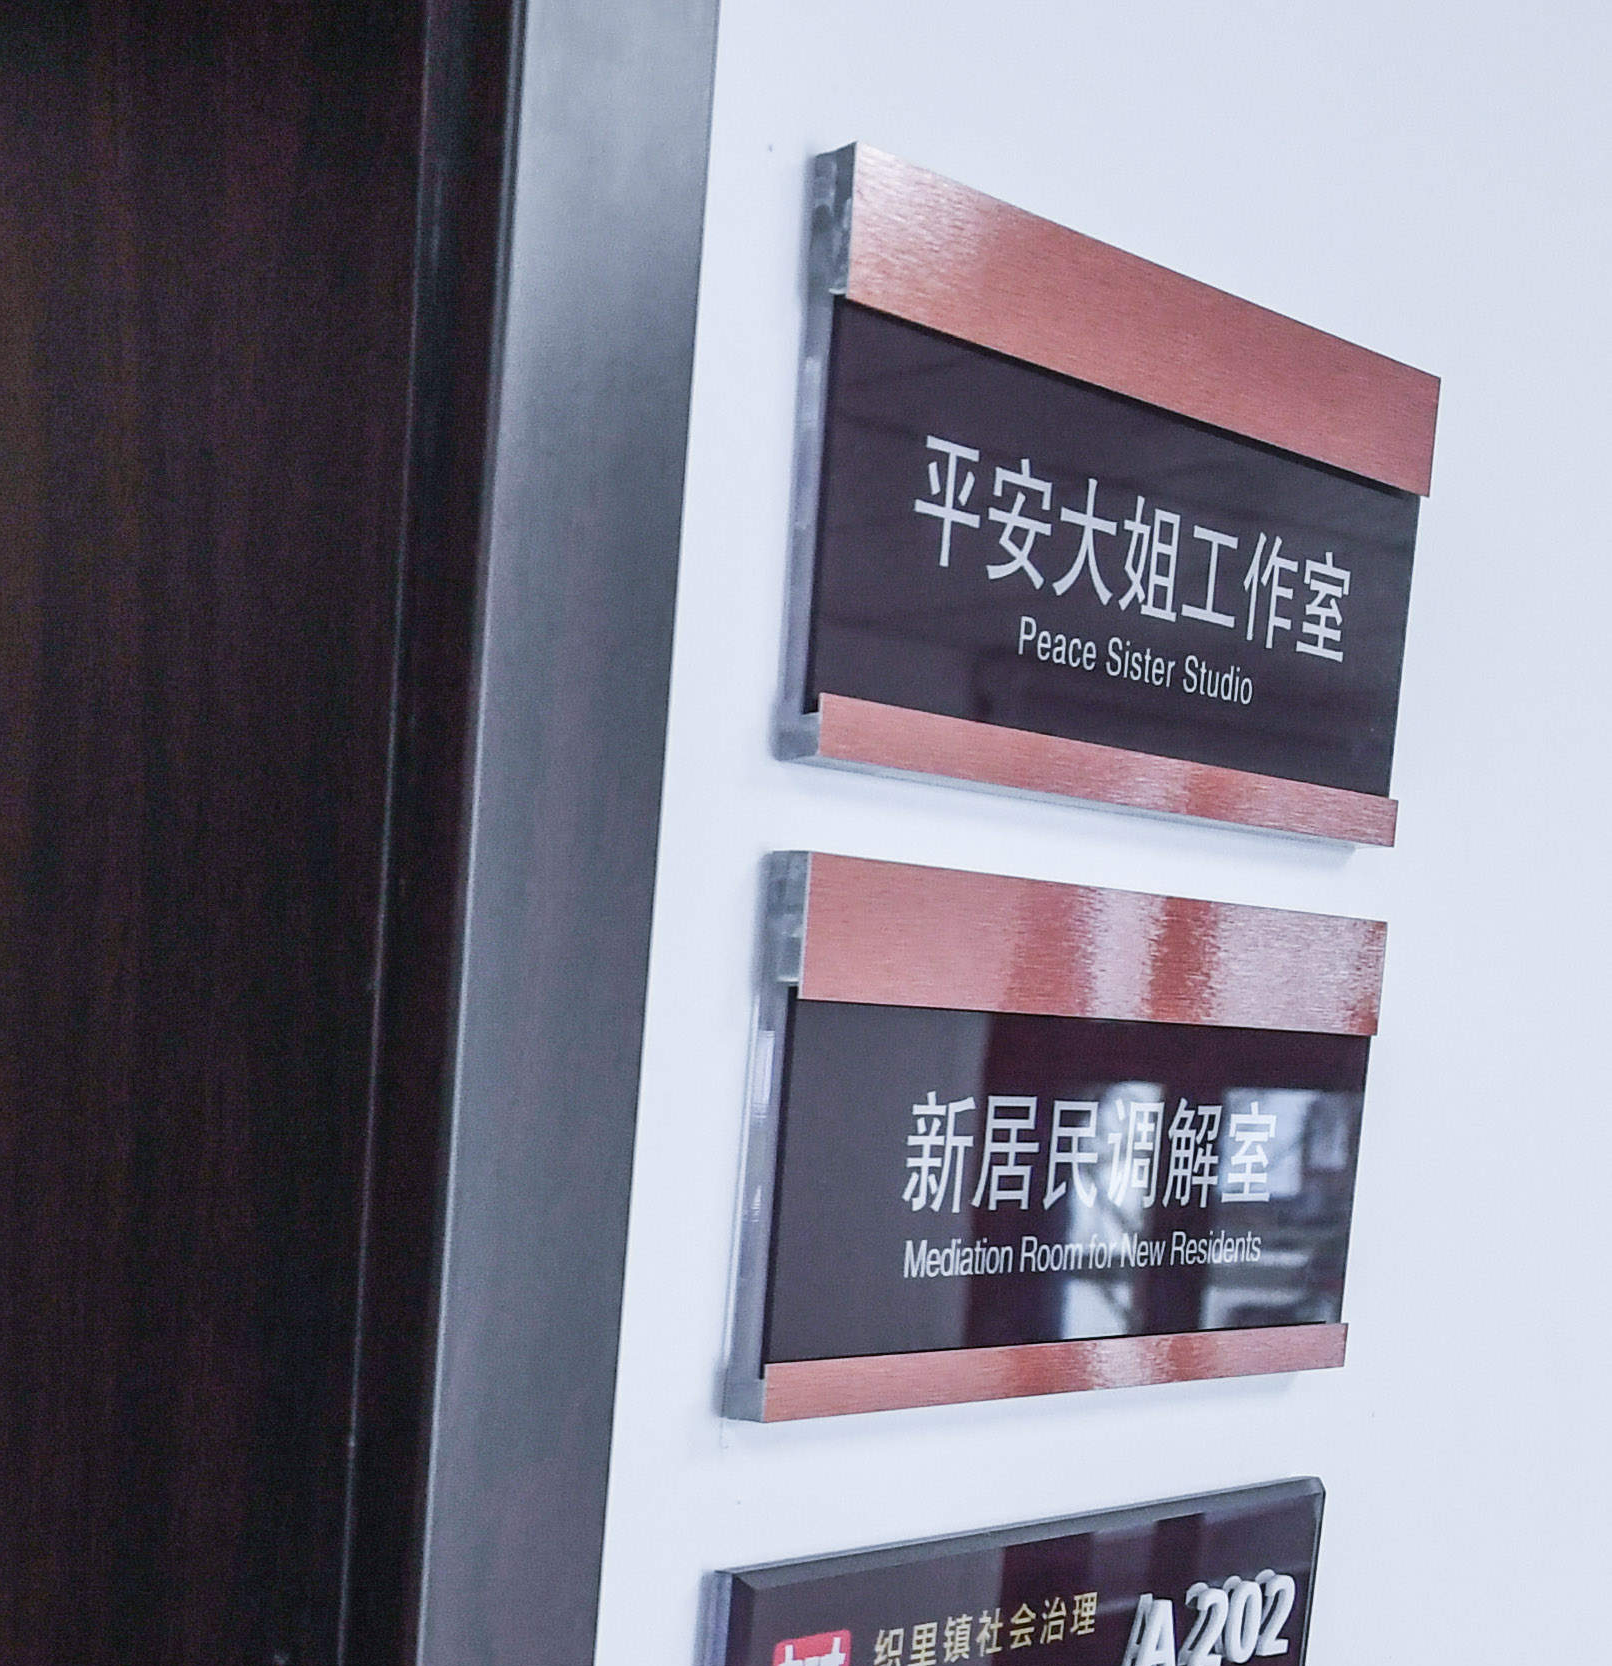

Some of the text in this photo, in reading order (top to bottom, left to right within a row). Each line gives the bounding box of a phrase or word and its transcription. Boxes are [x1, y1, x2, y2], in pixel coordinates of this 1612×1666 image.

[913, 433, 1352, 663] 平安大姐工作室
[1018, 615, 1254, 705] Peace Sister Studio
[902, 1090, 1278, 1214] 新居民调解室
[903, 1229, 1262, 1278] Mediation Room for New Residents
